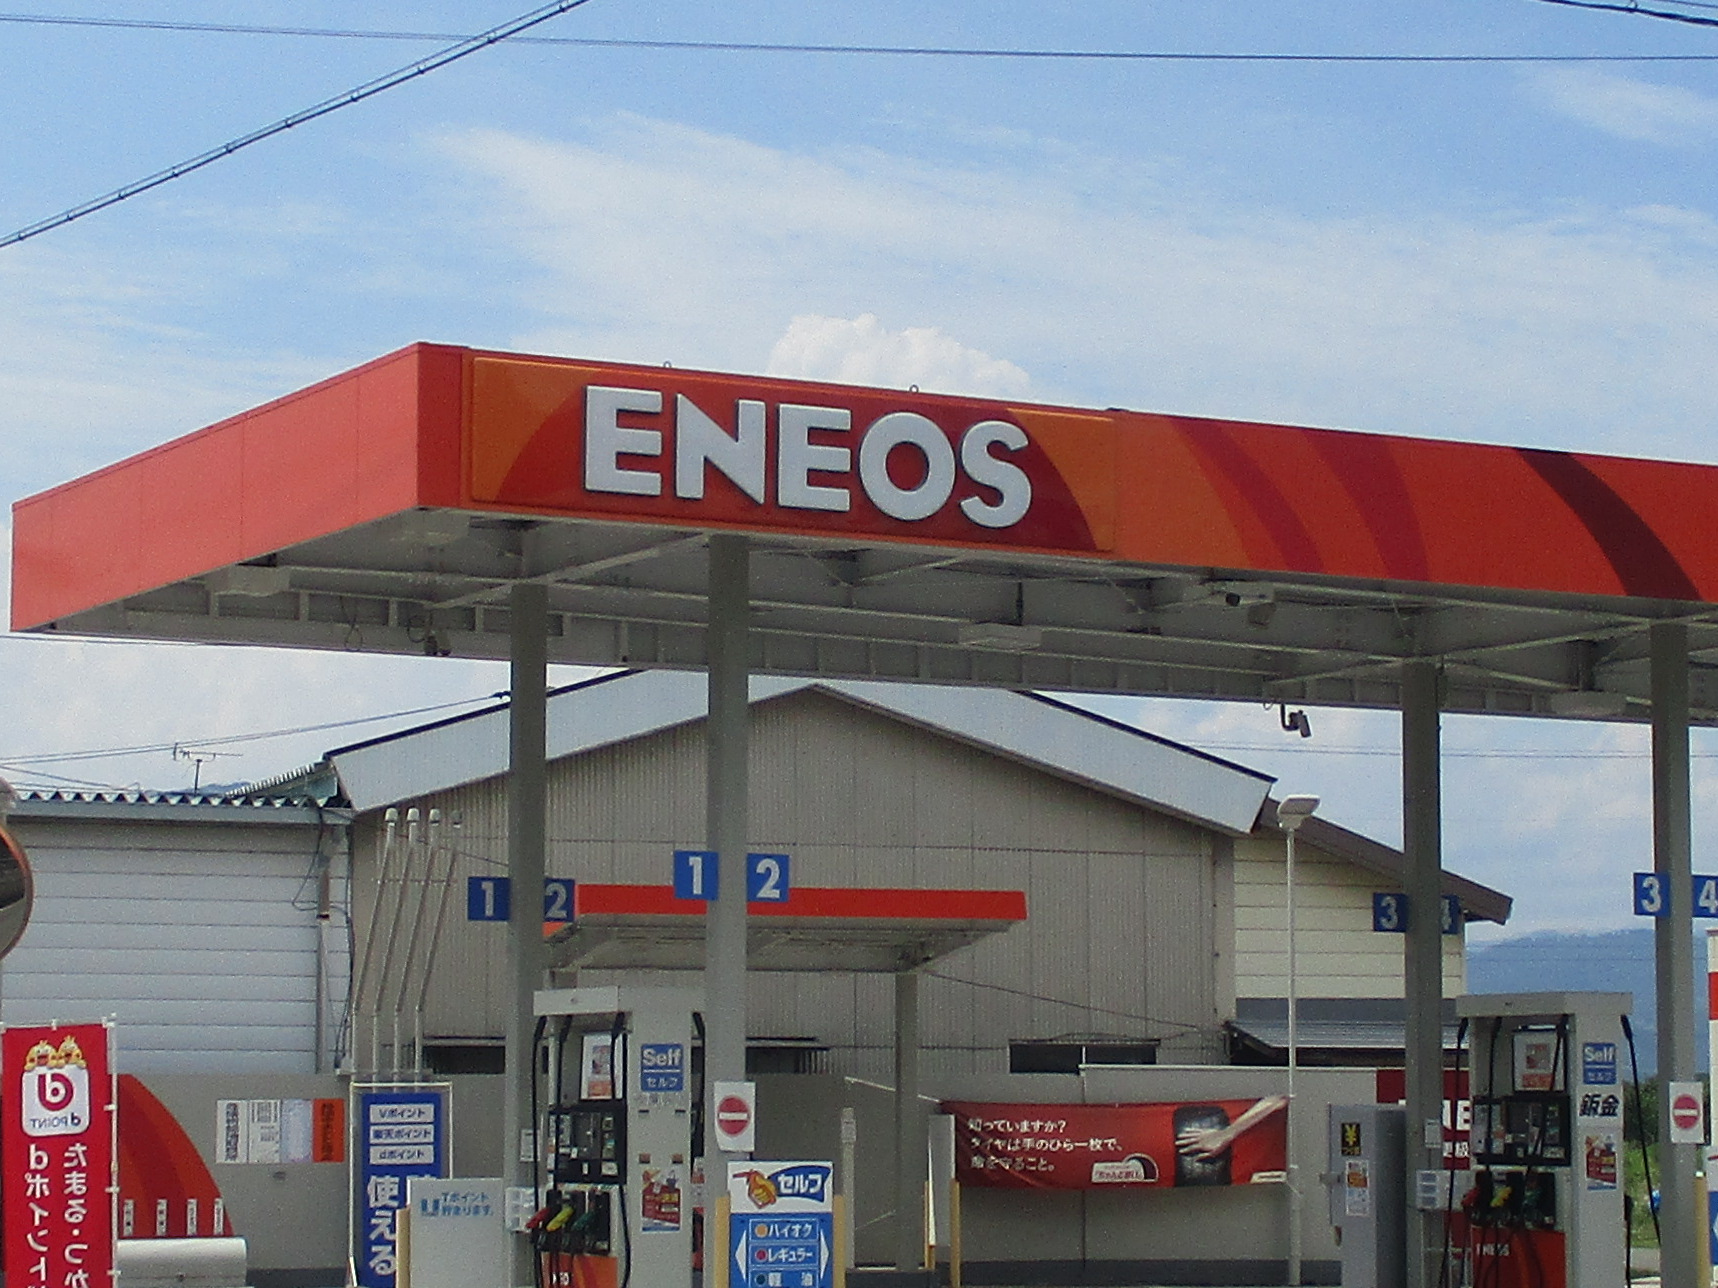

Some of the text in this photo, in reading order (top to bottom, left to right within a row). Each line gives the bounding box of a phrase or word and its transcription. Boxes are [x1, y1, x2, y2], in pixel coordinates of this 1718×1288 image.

[584, 384, 1032, 529] ENEOS
[688, 856, 703, 896] 1
[755, 858, 782, 900] 2
[481, 881, 495, 917] 1
[544, 882, 569, 920] 2
[1641, 876, 1663, 913] 3
[1381, 896, 1399, 930] 3
[642, 1048, 682, 1066] Self
[1584, 1046, 1614, 1062] Self
[646, 1077, 679, 1089] セルフ
[778, 1173, 822, 1195] セルフ
[367, 1174, 400, 1276] 使える
[768, 1223, 813, 1238] ハイオク
[768, 1248, 813, 1263] レギュラー
